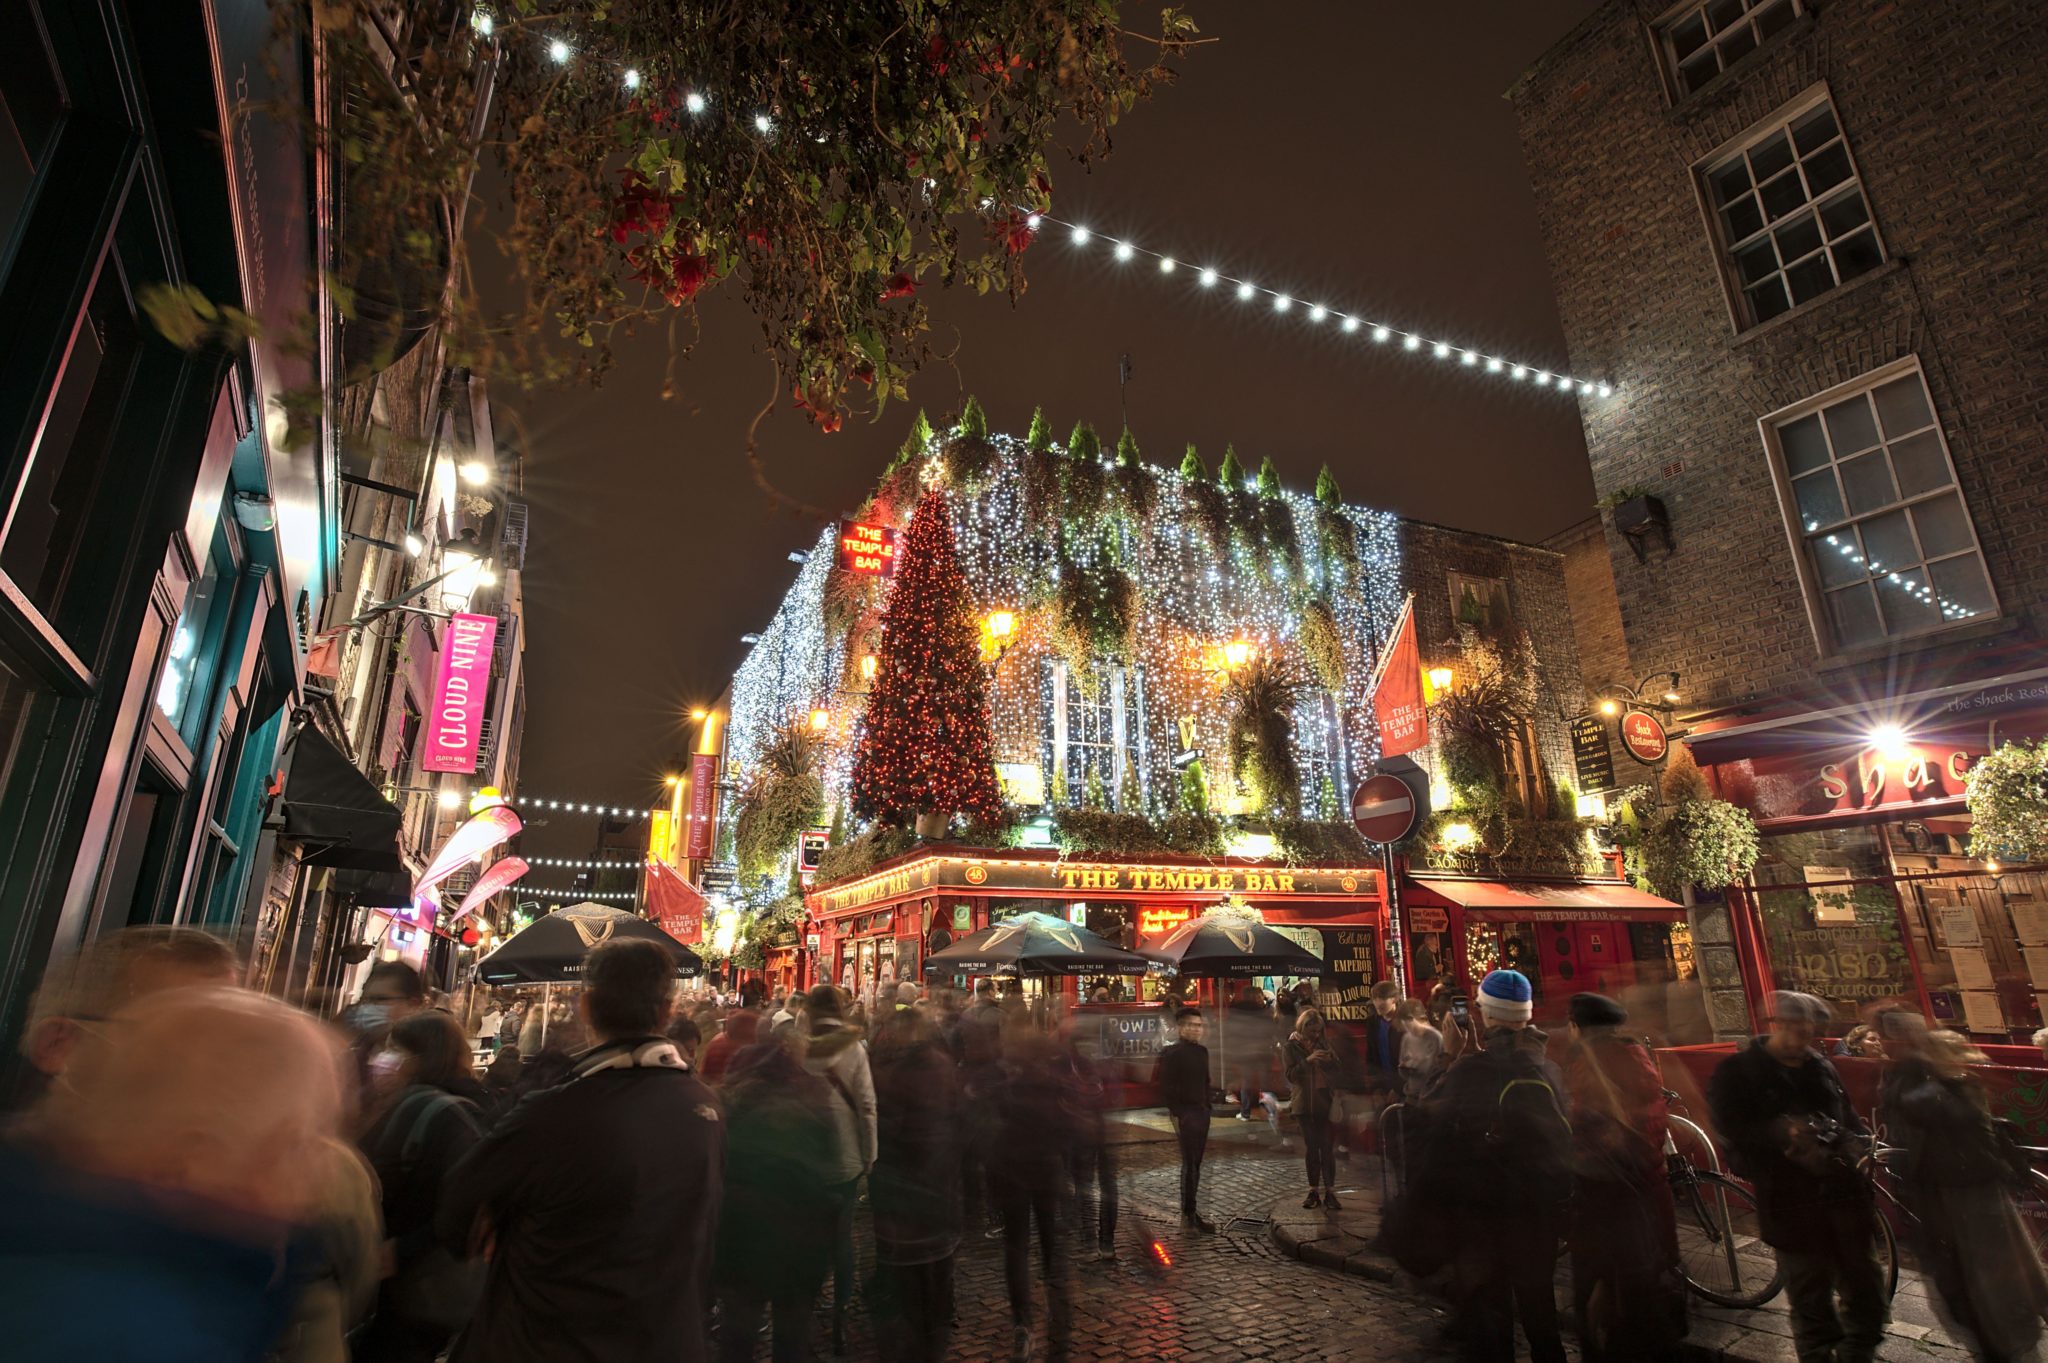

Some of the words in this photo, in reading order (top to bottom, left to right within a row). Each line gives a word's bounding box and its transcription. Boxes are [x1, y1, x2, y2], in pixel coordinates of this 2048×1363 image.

[856, 526, 882, 541] THE
[843, 539, 893, 556] TEMPLE
[855, 556, 881, 570] BAR
[450, 619, 487, 671] NINE
[438, 676, 469, 749] CLOUD
[1392, 704, 1411, 718] THE
[1381, 708, 1425, 732] TEMPLE
[1394, 724, 1414, 740] BAR
[1574, 724, 1604, 738] TEMPLE
[1580, 734, 1599, 744] BAR
[697, 768, 706, 786] BAR
[695, 788, 704, 824] TEMPLE
[693, 825, 702, 845] THE
[1060, 870, 1120, 890] THE
[1129, 870, 1235, 891] TEMPLE
[1245, 872, 1295, 892] BAR
[834, 892, 850, 909] THE
[851, 884, 886, 905] TEMPLE
[888, 873, 910, 896] BAR
[664, 918, 700, 928] TEMPLE
[1533, 912, 1552, 920] THE
[1553, 912, 1590, 920] TEMPLE
[1590, 912, 1609, 920] BAR
[674, 927, 692, 935] BAR
[1290, 932, 1310, 941] THE
[1294, 940, 1319, 950] MPLE
[1352, 946, 1371, 959] THE
[1334, 960, 1372, 972] EMPEROR
[1362, 972, 1372, 984] OF
